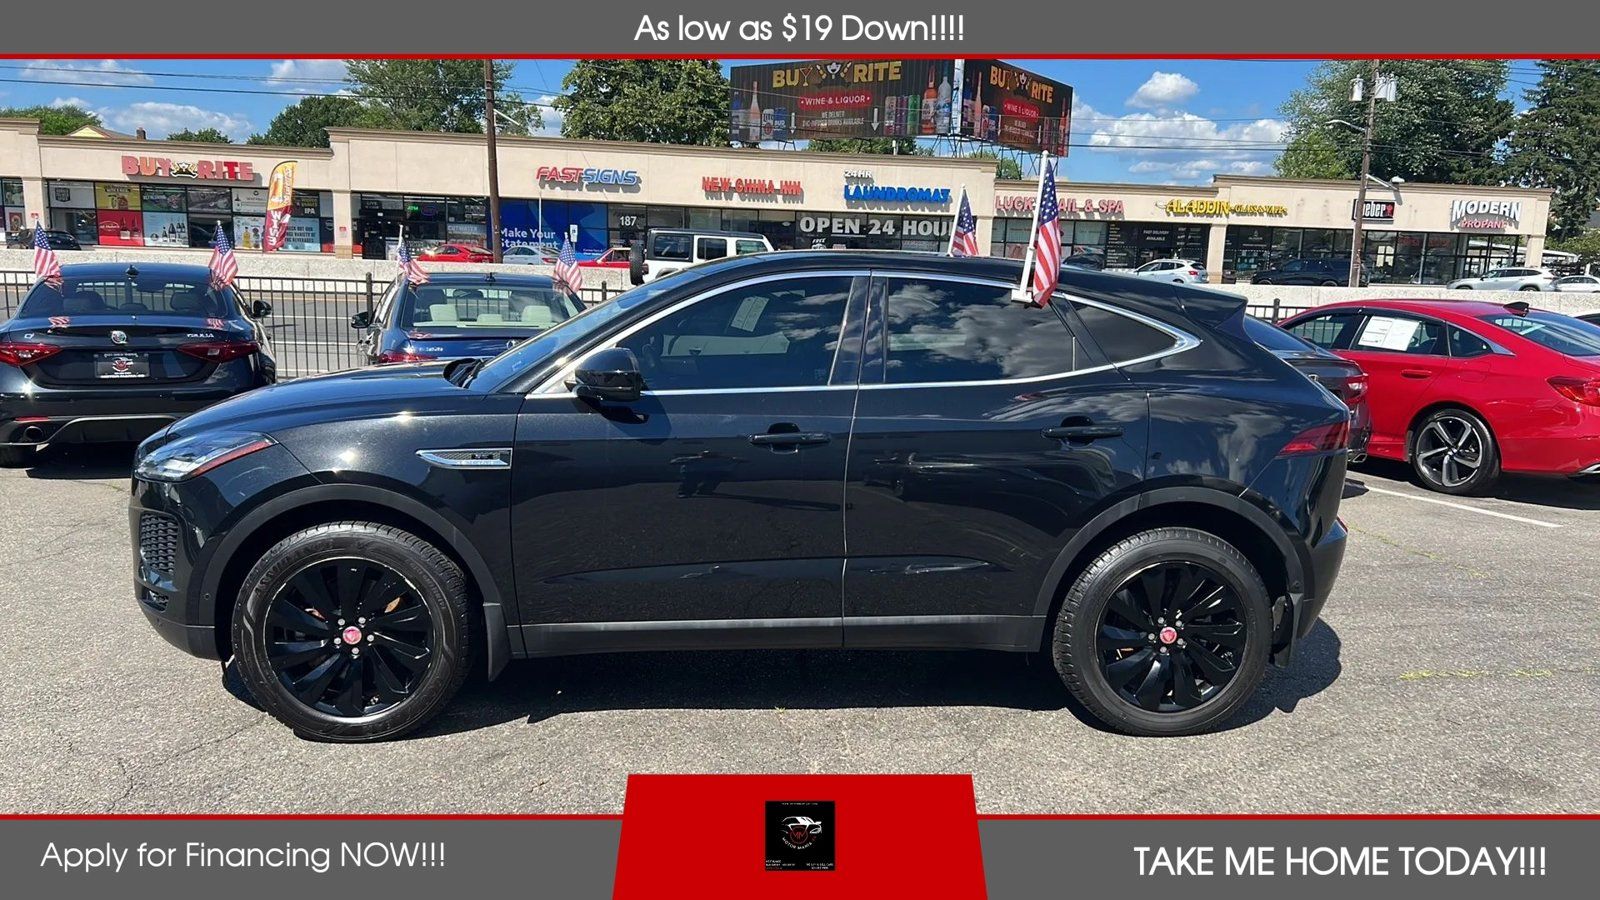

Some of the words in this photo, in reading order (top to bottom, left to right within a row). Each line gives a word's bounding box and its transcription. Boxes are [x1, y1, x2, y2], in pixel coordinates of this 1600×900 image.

[853, 61, 902, 83] RITE
[804, 97, 826, 106] WINE
[835, 95, 866, 104] LIQUOR
[1031, 80, 1054, 104] RITE
[121, 156, 171, 177] BUY
[198, 160, 254, 182] RITE
[536, 166, 637, 185] FASTSIGNS
[702, 176, 730, 192] NEW
[735, 178, 775, 194] CHINA
[780, 180, 801, 195] INN
[844, 185, 951, 203] LAUNDROMAT
[1057, 198, 1079, 213] AIL
[1084, 199, 1094, 213] &
[1099, 200, 1125, 214] SPA
[1165, 199, 1229, 216] ALADDIN
[1362, 201, 1386, 217] eber
[1451, 200, 1522, 221] MODERN
[620, 215, 637, 226] 187
[800, 216, 860, 234] OPEN
[868, 219, 895, 235] 24
[1459, 218, 1509, 229] PROPANE
[501, 227, 528, 238] Make
[529, 229, 556, 239] Your
